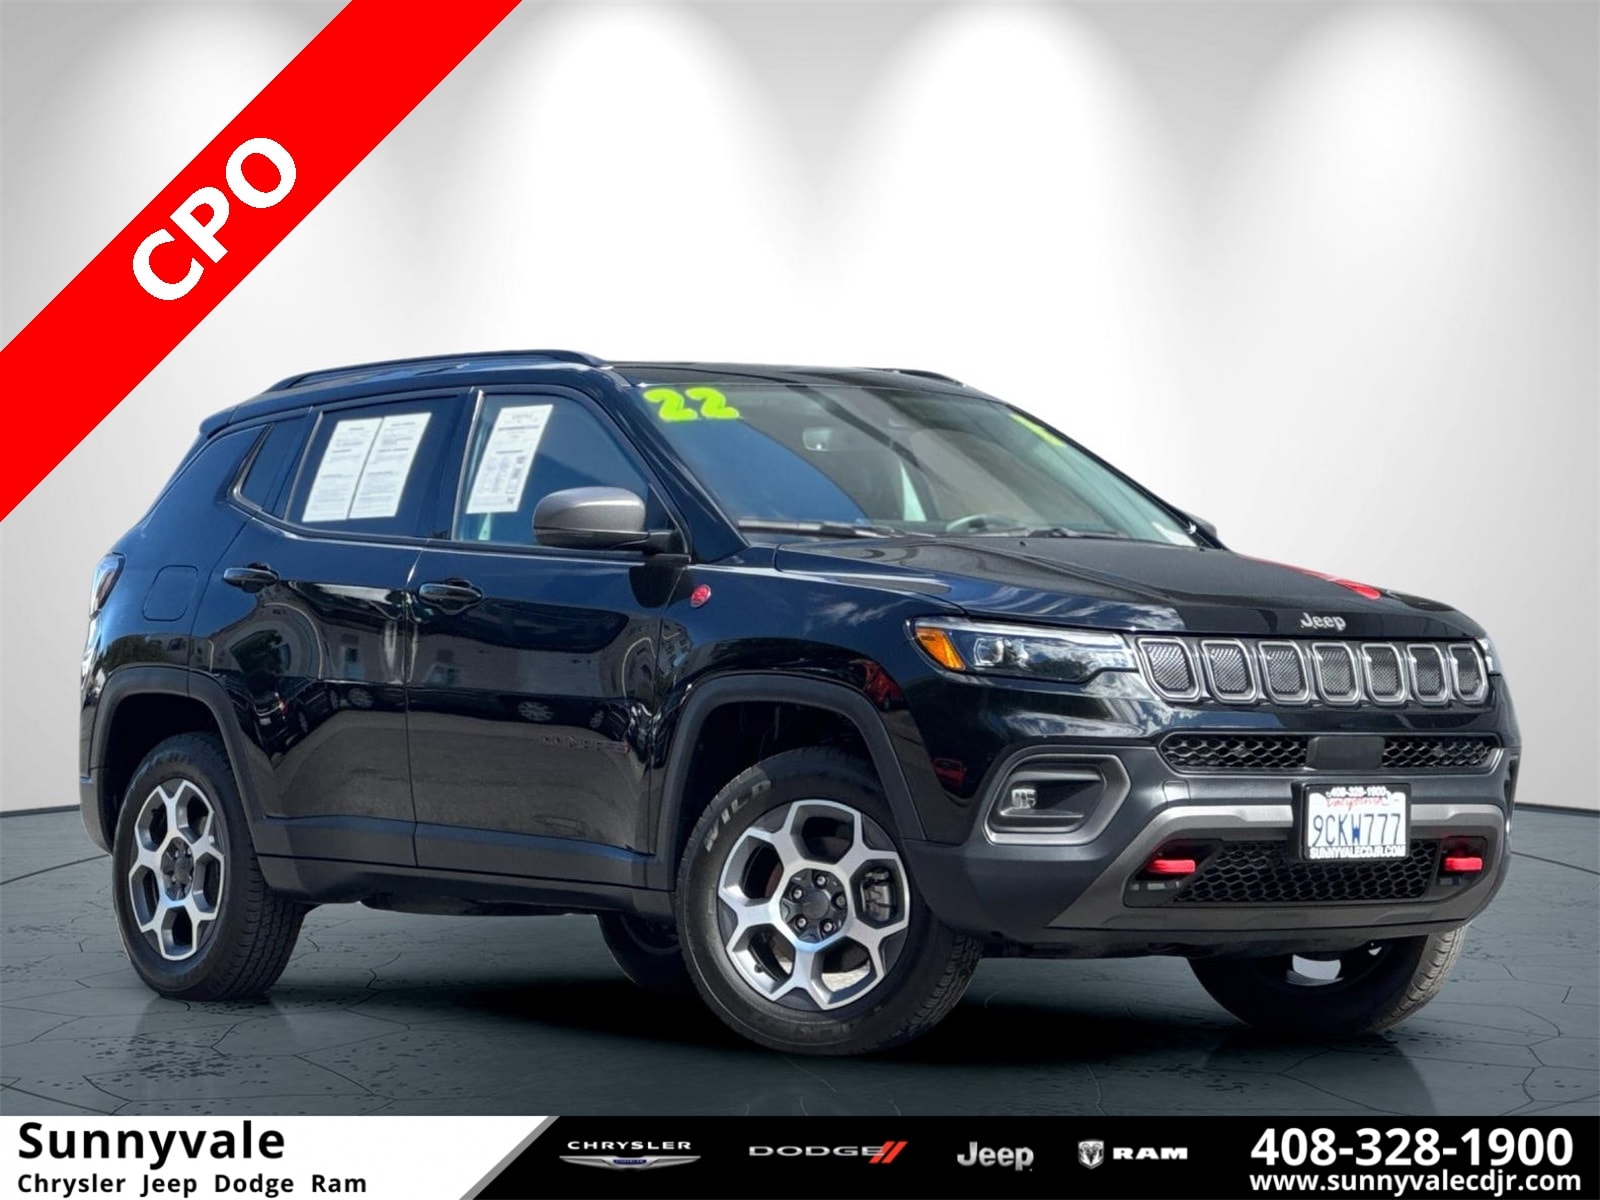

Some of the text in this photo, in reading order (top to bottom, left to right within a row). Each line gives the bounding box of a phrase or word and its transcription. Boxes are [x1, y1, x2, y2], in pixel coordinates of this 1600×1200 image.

[643, 387, 740, 421] 22
[1300, 612, 1346, 631] Jeep
[1312, 812, 1402, 847] 9CKW777
